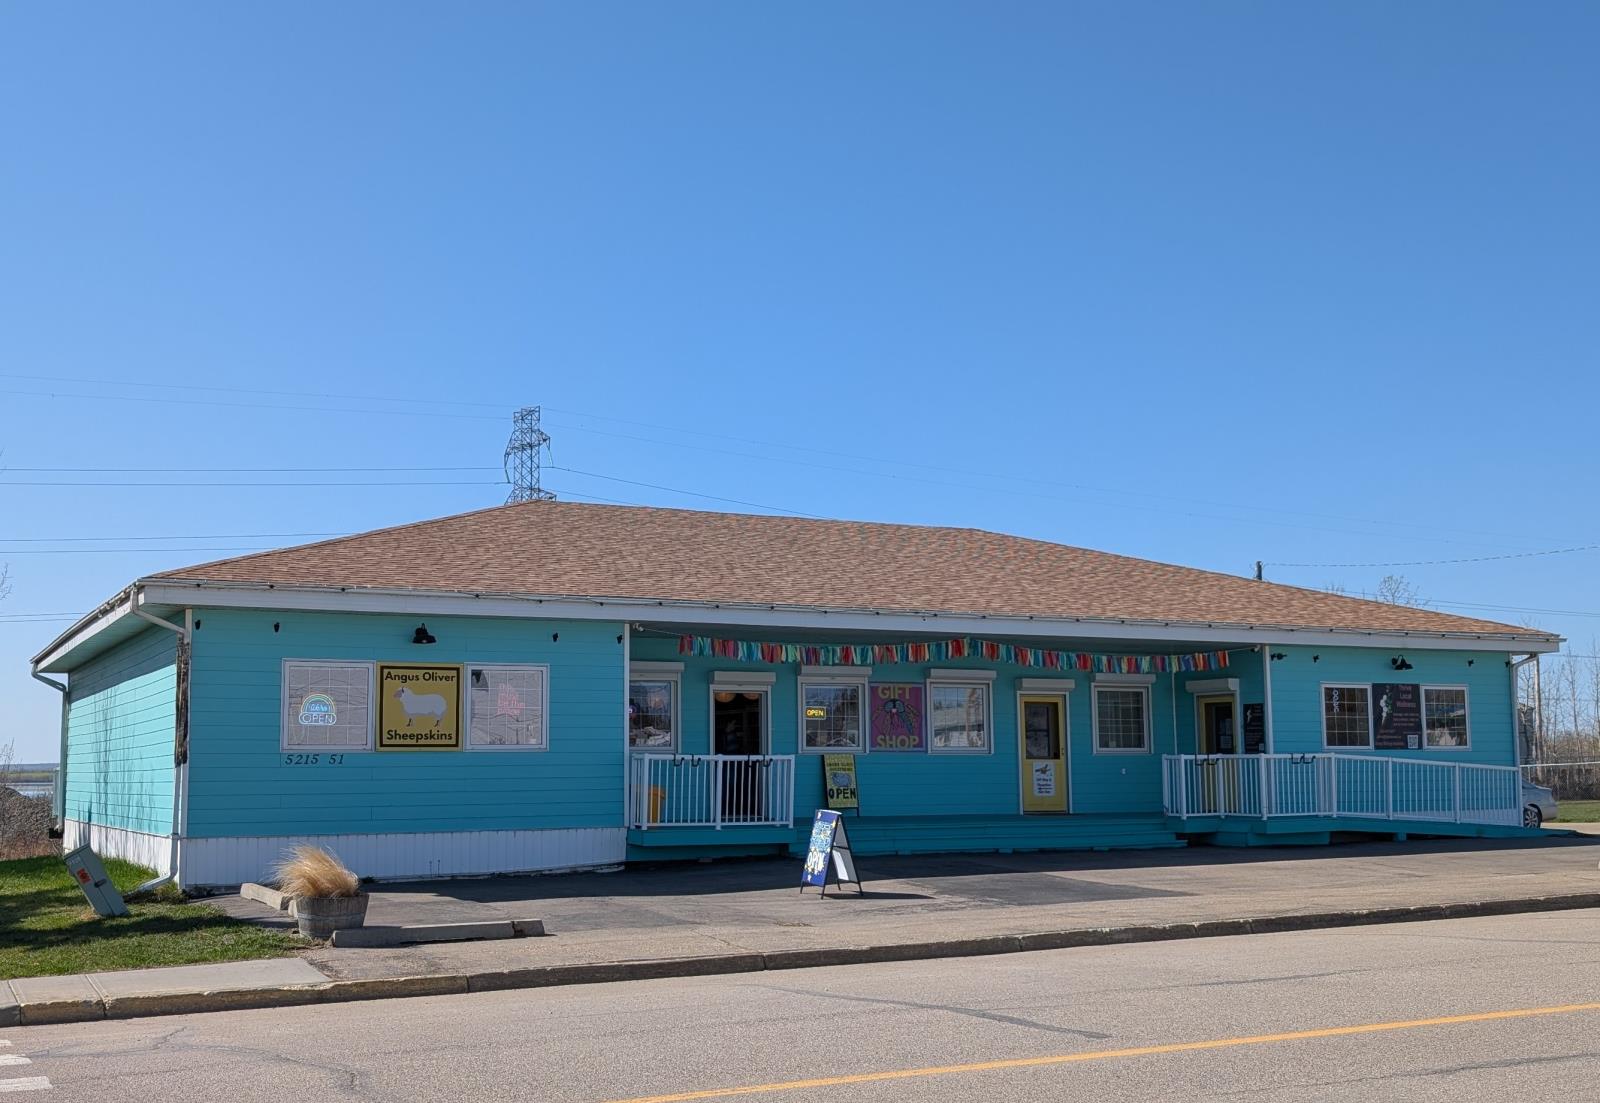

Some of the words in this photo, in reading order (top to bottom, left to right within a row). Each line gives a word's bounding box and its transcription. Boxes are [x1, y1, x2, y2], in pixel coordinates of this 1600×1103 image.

[385, 671, 420, 683] Angus
[422, 672, 456, 682] Oliver
[877, 684, 913, 699] GIFT
[302, 714, 333, 723] OPEN
[806, 709, 824, 717] OPEN
[386, 729, 453, 743] Sheepskins
[876, 735, 919, 749] SHOP
[285, 754, 320, 765] 5215
[328, 754, 344, 765] 51
[828, 787, 857, 799] OPEN
